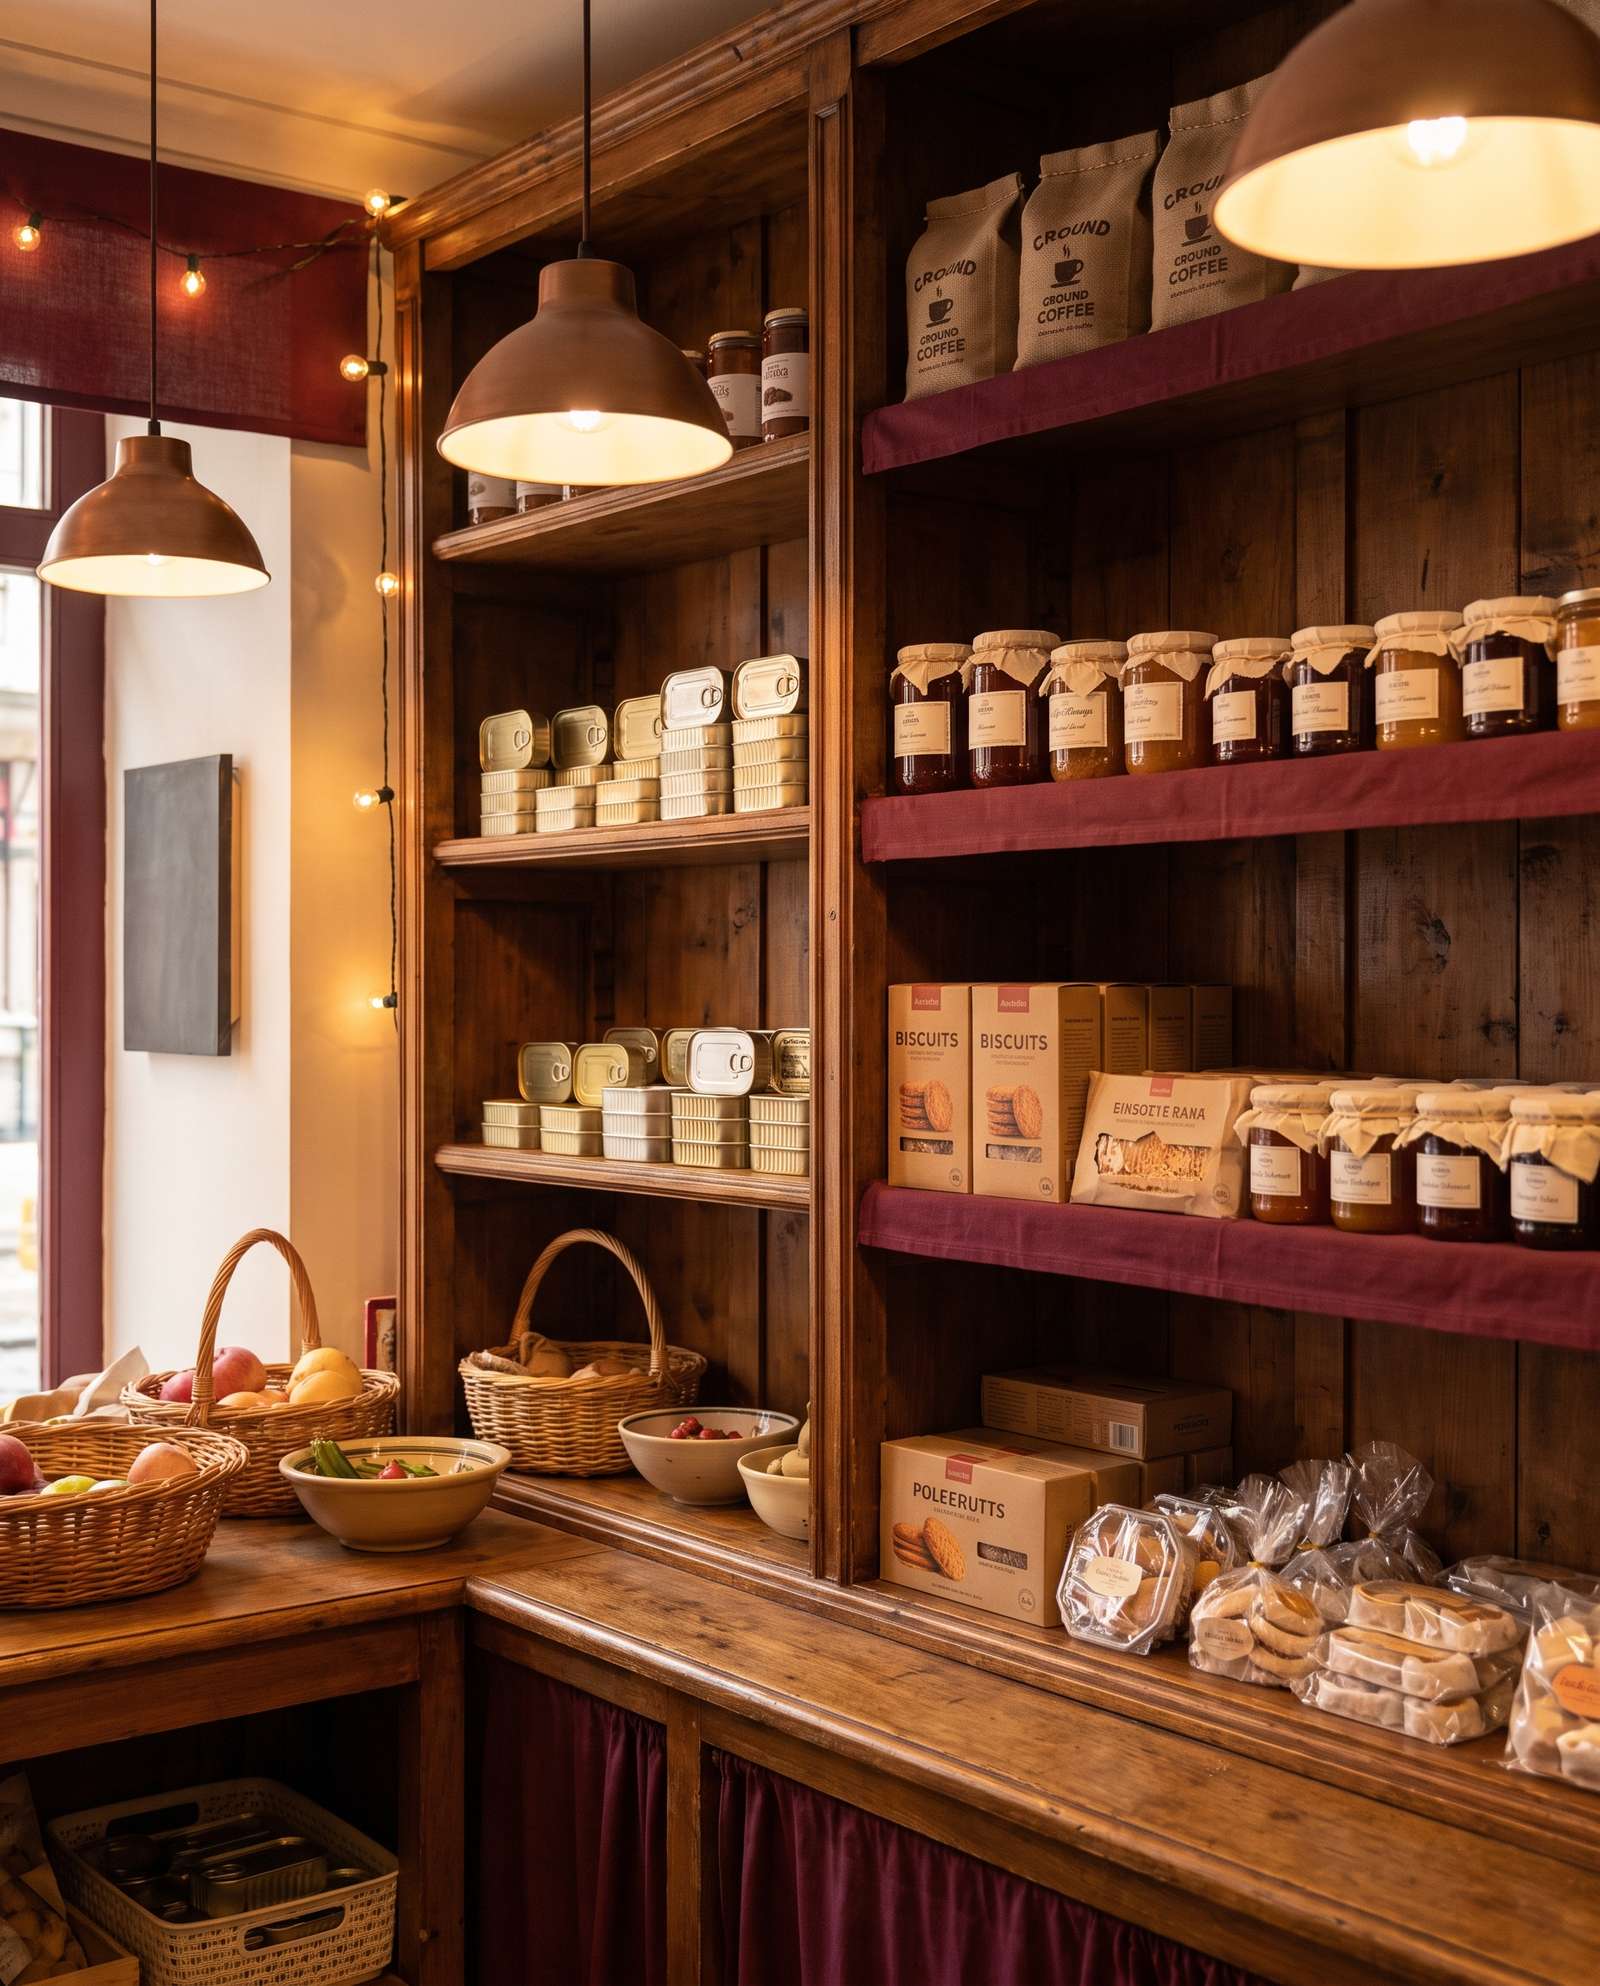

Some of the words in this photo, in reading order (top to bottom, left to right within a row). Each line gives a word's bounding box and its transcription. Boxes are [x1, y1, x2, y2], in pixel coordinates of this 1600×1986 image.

[1169, 257, 1229, 285] COFFEE
[1037, 302, 1095, 324] COFFEE
[917, 338, 966, 362] COFFEE
[895, 1031, 959, 1047] BISCUITS
[980, 1033, 1048, 1050] BISCUITS
[913, 1482, 1005, 1519] POLEERUTTS
